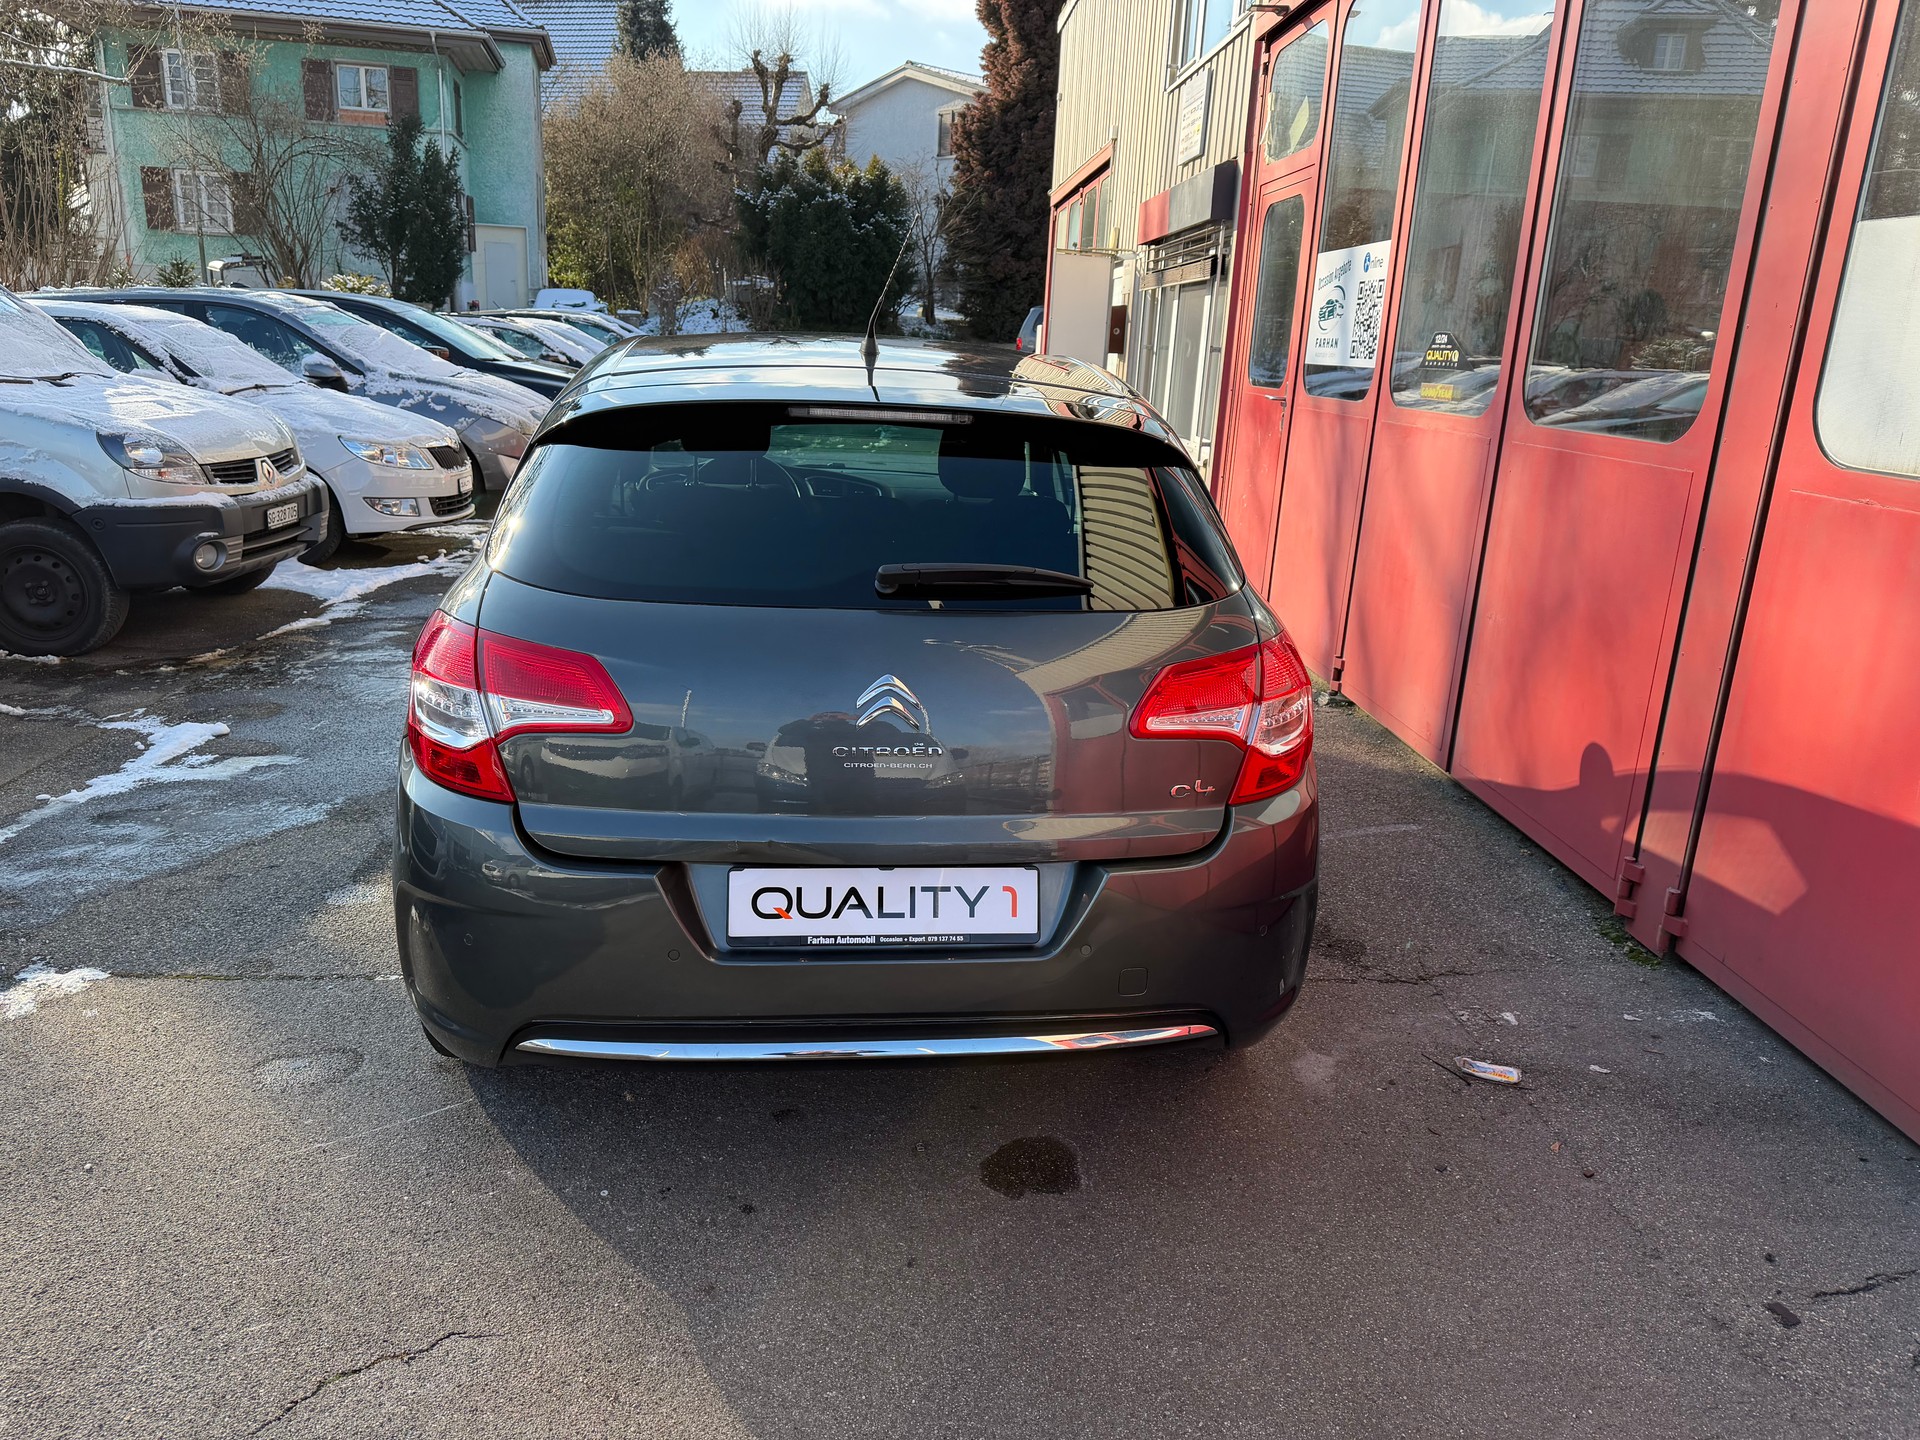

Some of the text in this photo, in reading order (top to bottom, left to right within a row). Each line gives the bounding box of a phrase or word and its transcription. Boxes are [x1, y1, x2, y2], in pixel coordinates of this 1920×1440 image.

[1314, 337, 1339, 349] FARHAN
[751, 885, 1018, 920] QUALITY 1
[807, 936, 835, 945] Farhan
[836, 935, 876, 944] Automobil
